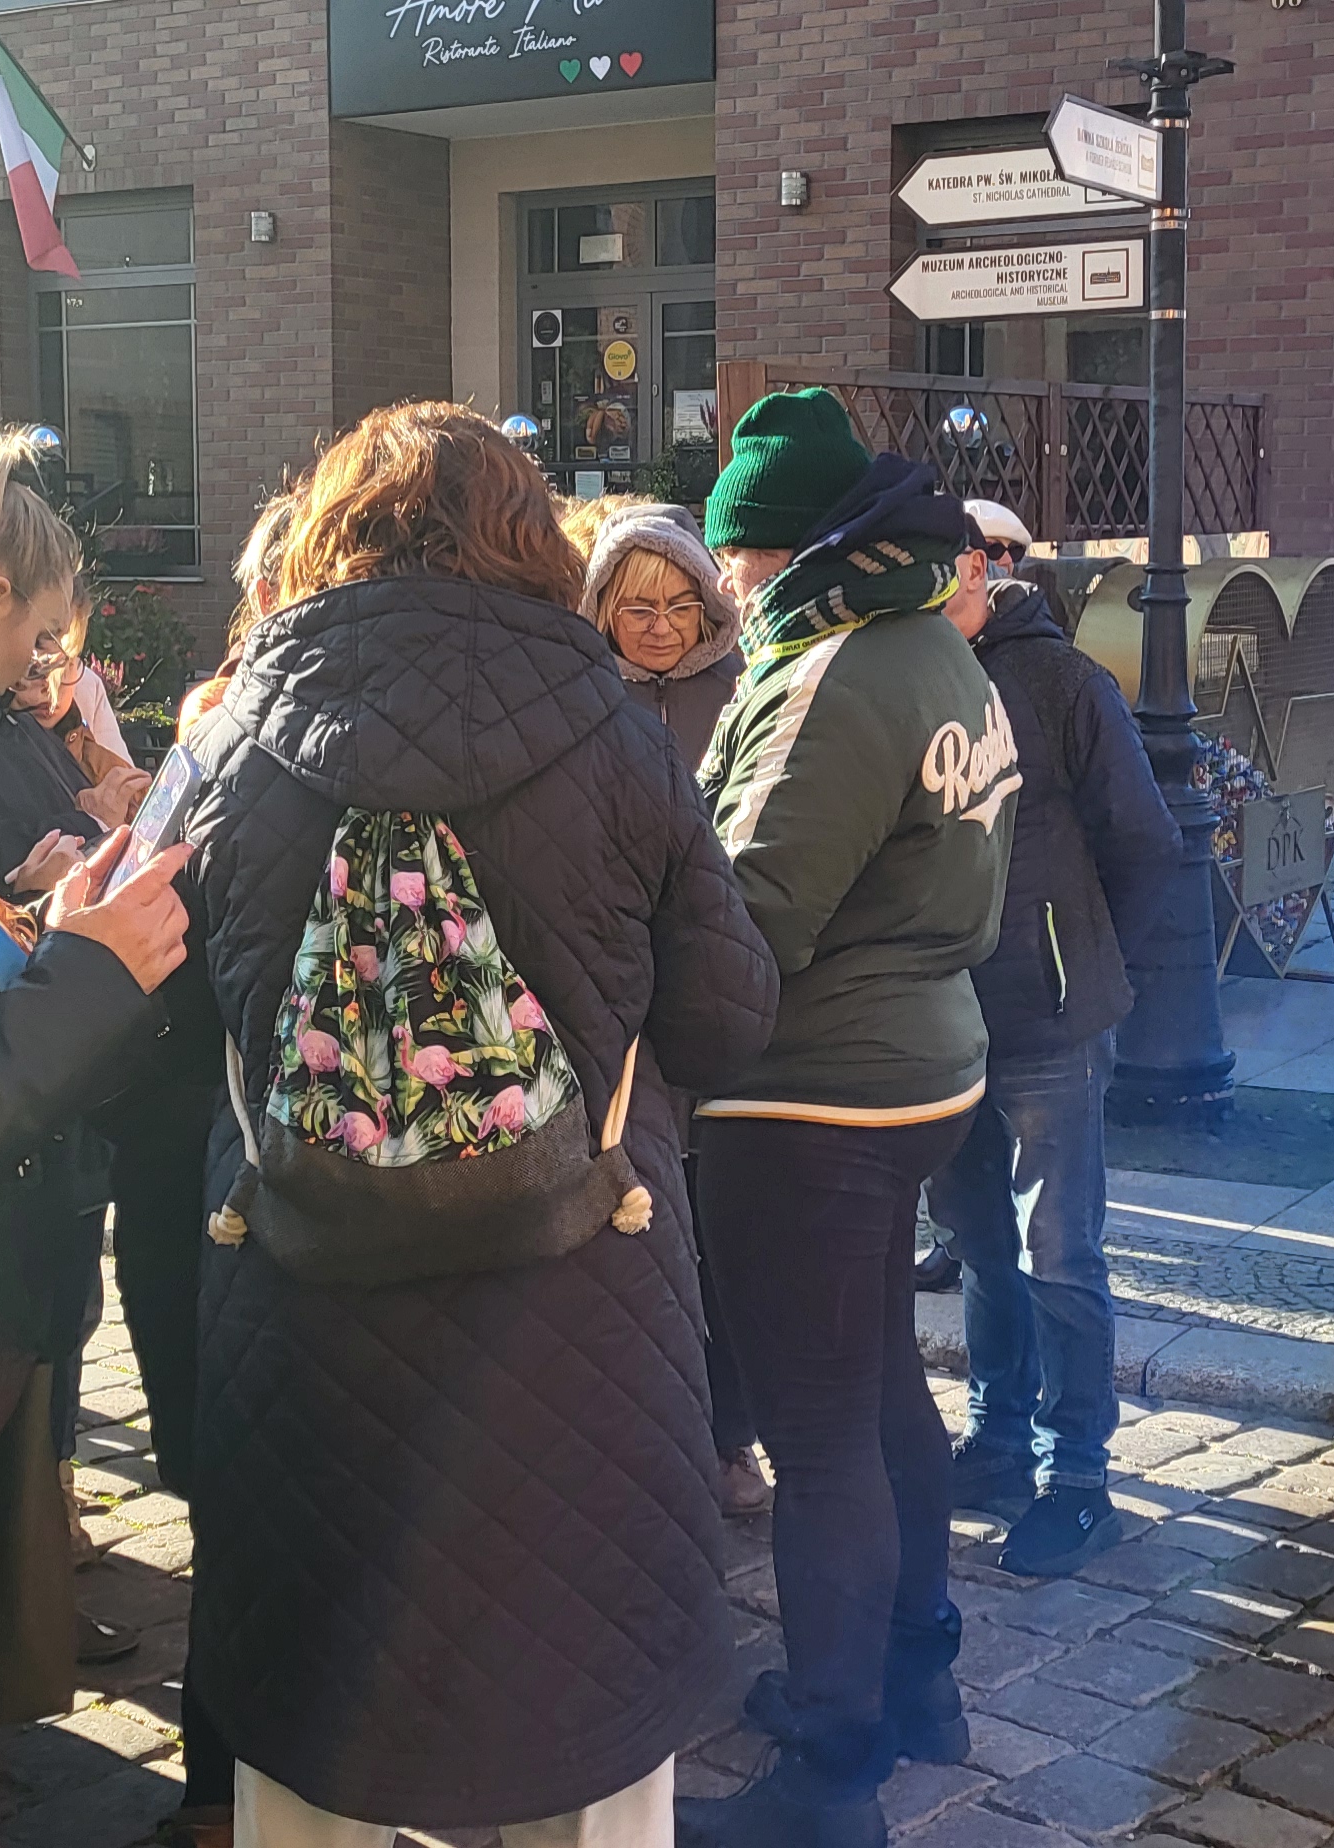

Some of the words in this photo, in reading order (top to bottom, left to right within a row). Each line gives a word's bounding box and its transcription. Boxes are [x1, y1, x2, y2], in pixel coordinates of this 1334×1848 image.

[421, 36, 500, 67] Ristorante
[508, 25, 577, 59] Italiano
[928, 175, 974, 191] KATEDRA
[976, 173, 995, 187] PW.
[998, 169, 1016, 186] ŚW.
[1020, 168, 1060, 184] MIKOŁA
[972, 191, 985, 204] ST.
[985, 189, 1025, 203] NICHOLAS
[1026, 185, 1071, 200] CATHEDRAL
[921, 258, 965, 273] MUZEUM
[968, 250, 1067, 270] ARCHEOLOGICZNO-
[996, 267, 1068, 285] HISTORYCZNE
[951, 287, 1009, 300] ARCHEOLOGICAL
[1010, 285, 1025, 296] AND
[1026, 283, 1068, 295] HISTORICAL
[1037, 296, 1068, 306] MUSEUM
[608, 352, 628, 360] Glovo
[1267, 830, 1305, 870] DPK
